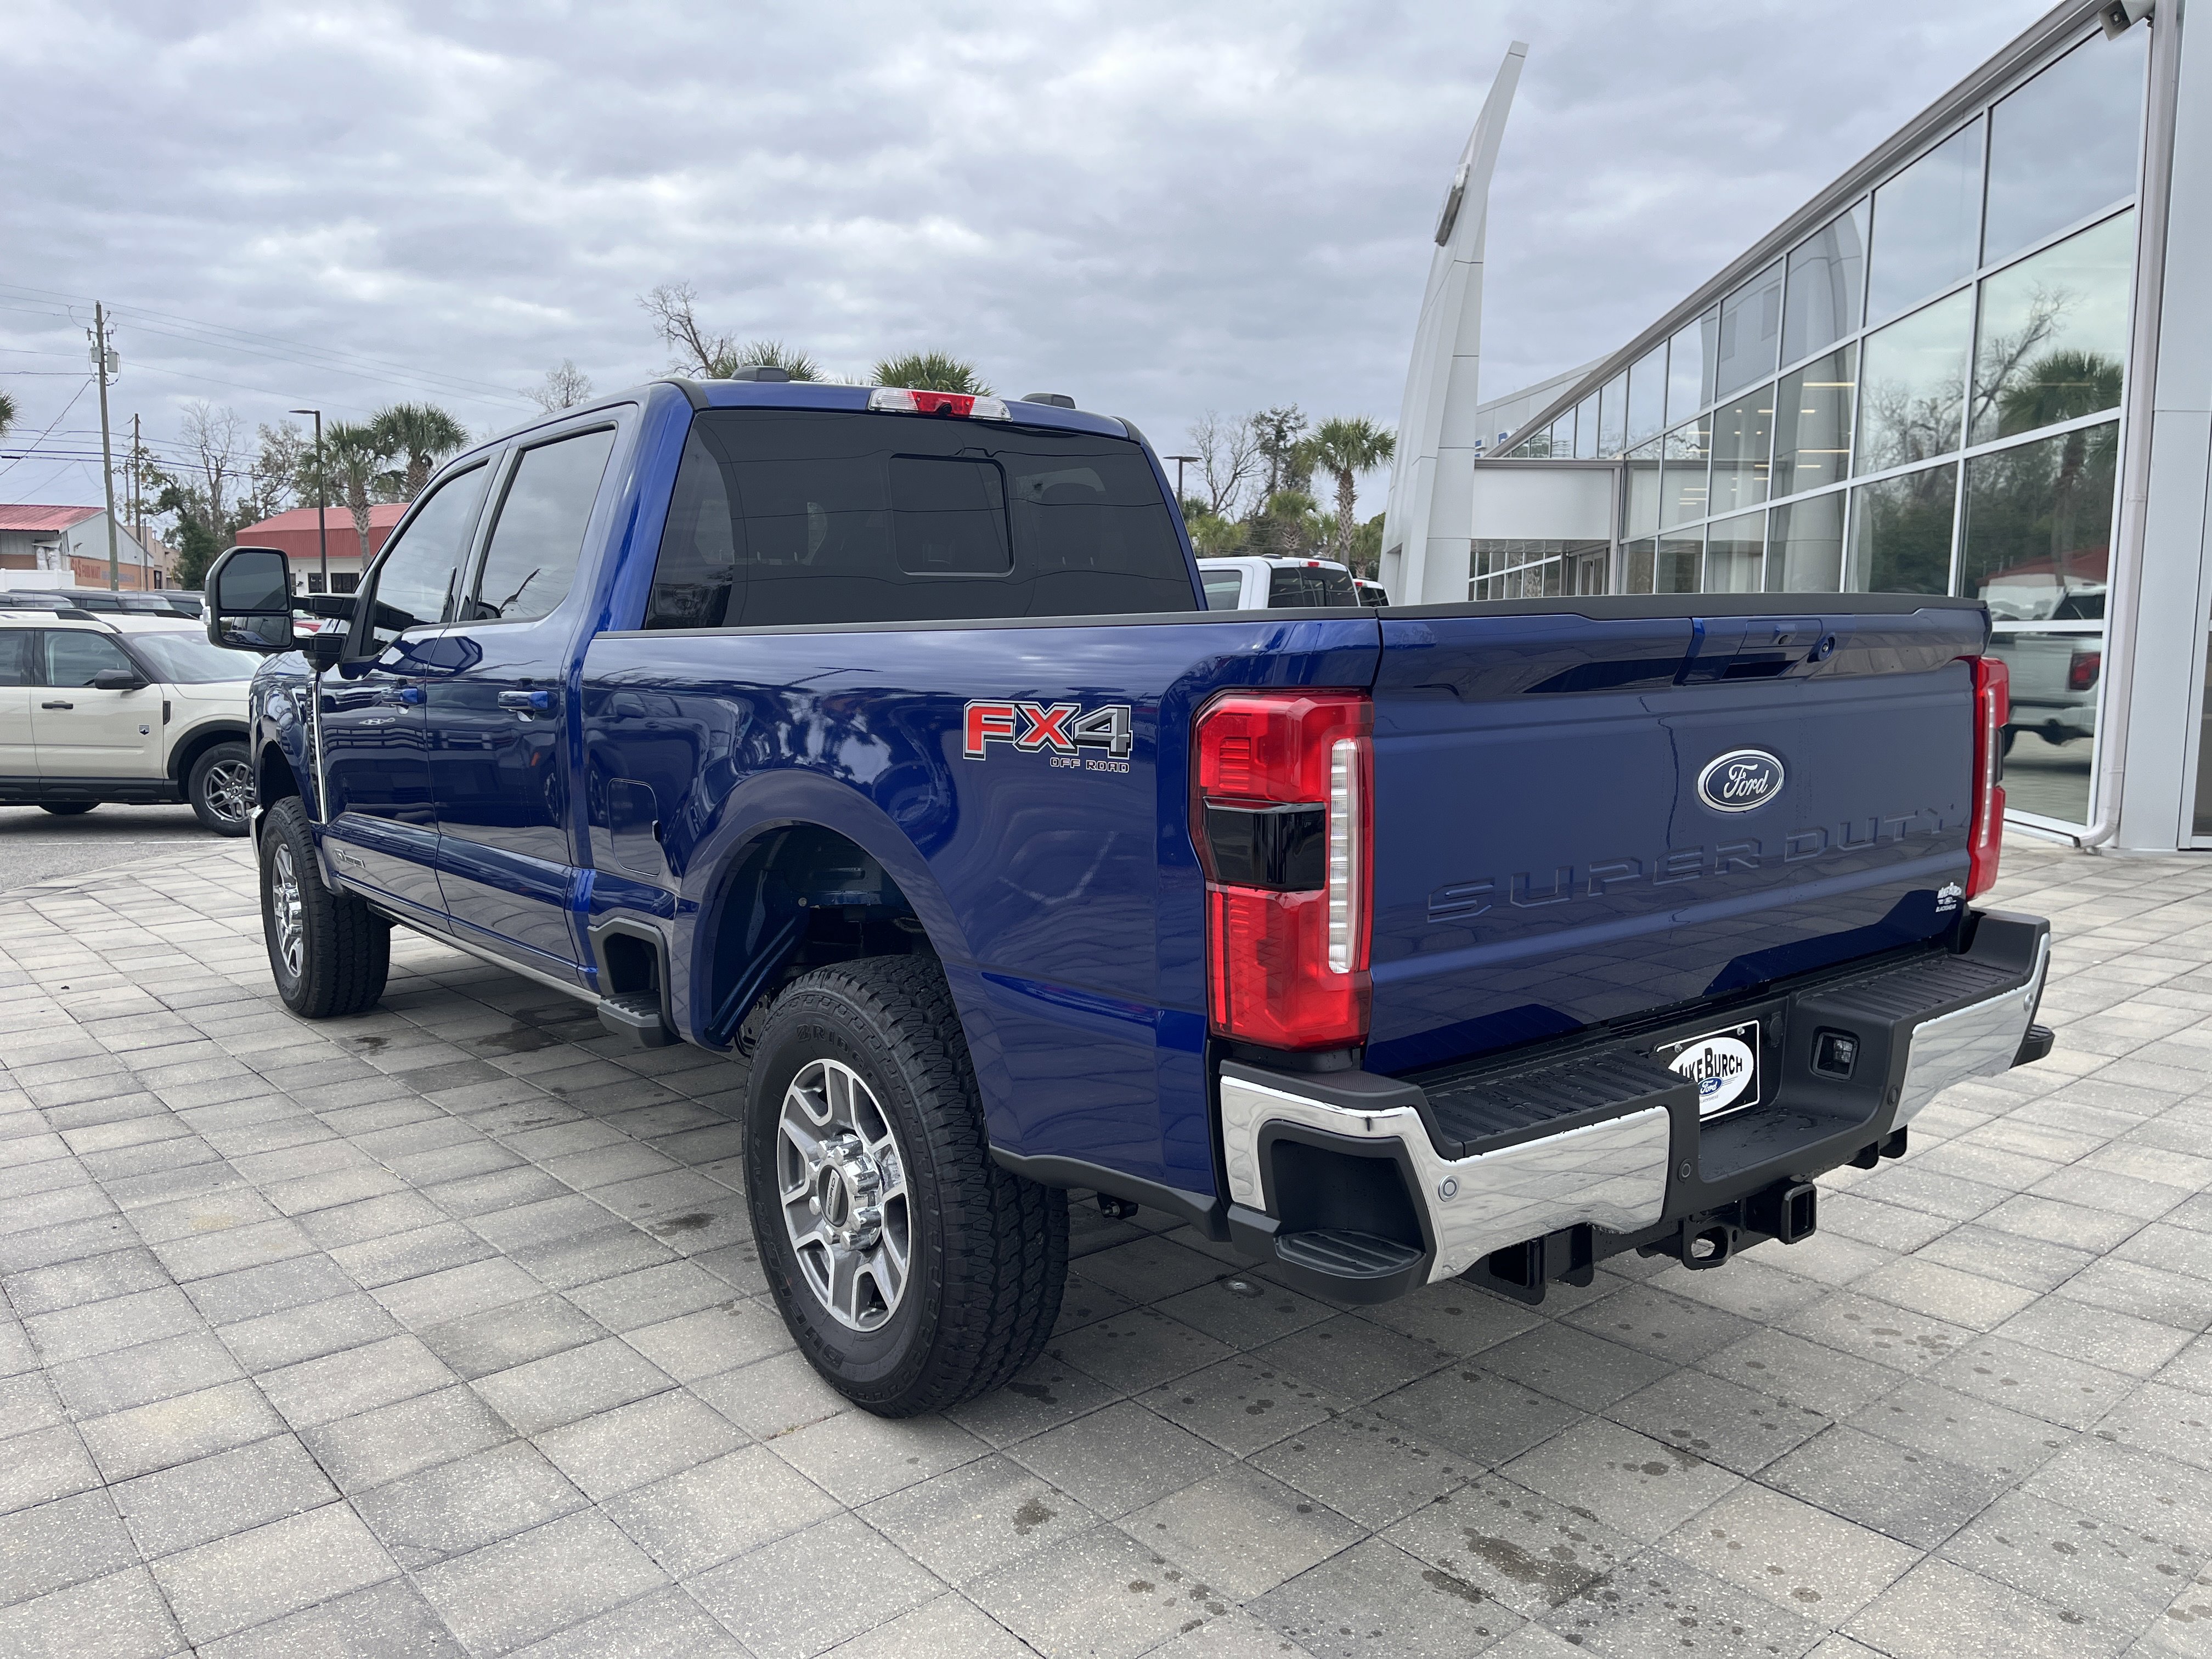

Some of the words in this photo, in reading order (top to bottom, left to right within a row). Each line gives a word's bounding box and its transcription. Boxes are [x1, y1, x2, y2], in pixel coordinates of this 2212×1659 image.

[963, 699, 1133, 761] FX4
[1049, 757, 1081, 768] OFF
[1086, 760, 1130, 774] ROAD
[1427, 836, 1760, 924] SUPER
[1784, 803, 1955, 863] DUTY
[1704, 1047, 1743, 1079] BURCH
[1700, 1079, 1718, 1094] Ford
[827, 1177, 836, 1216] FORD
